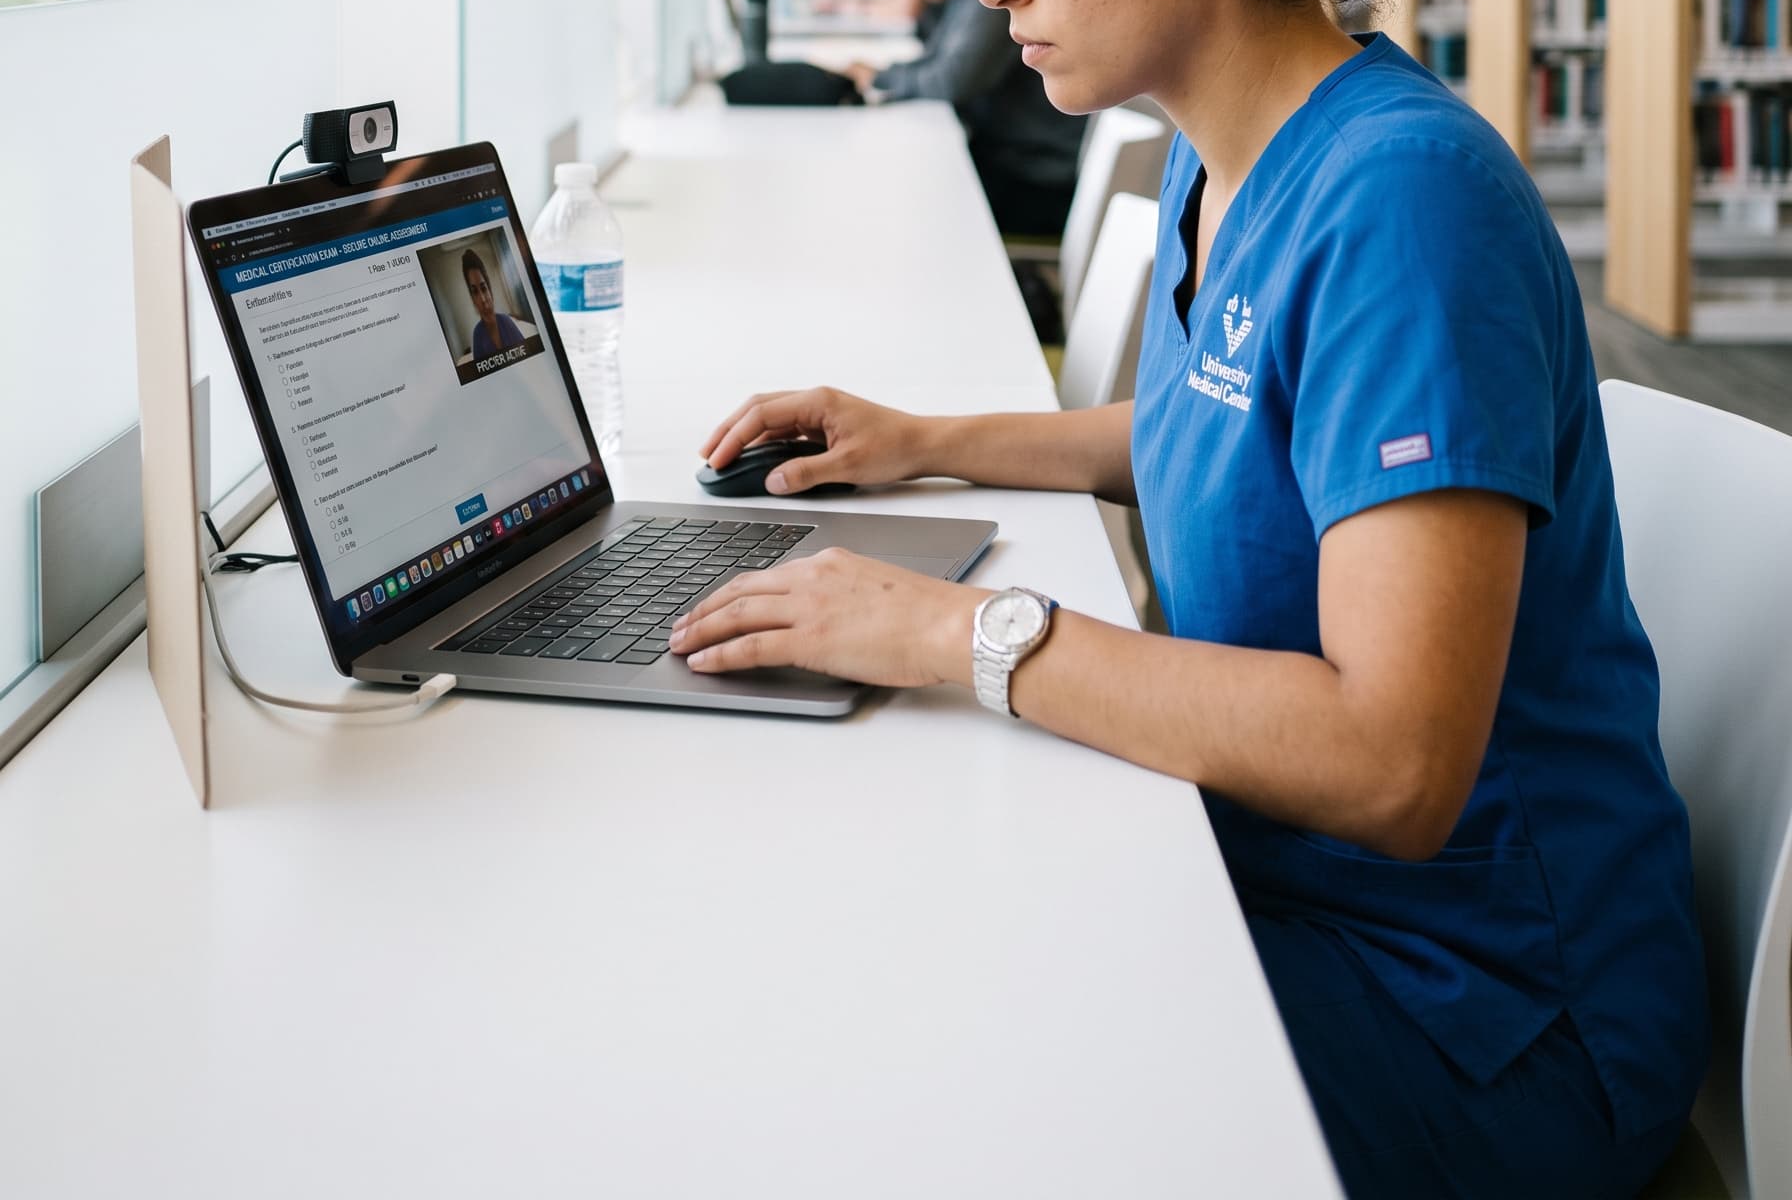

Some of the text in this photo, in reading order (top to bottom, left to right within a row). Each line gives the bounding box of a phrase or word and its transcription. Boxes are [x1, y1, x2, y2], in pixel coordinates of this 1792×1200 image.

[235, 265, 269, 283] MEDICAL
[268, 253, 319, 274] CERTIFICATION
[318, 247, 339, 261] EXAM
[342, 239, 368, 254] SECURE
[1187, 368, 1224, 401] Medical
[1201, 350, 1252, 392] University
